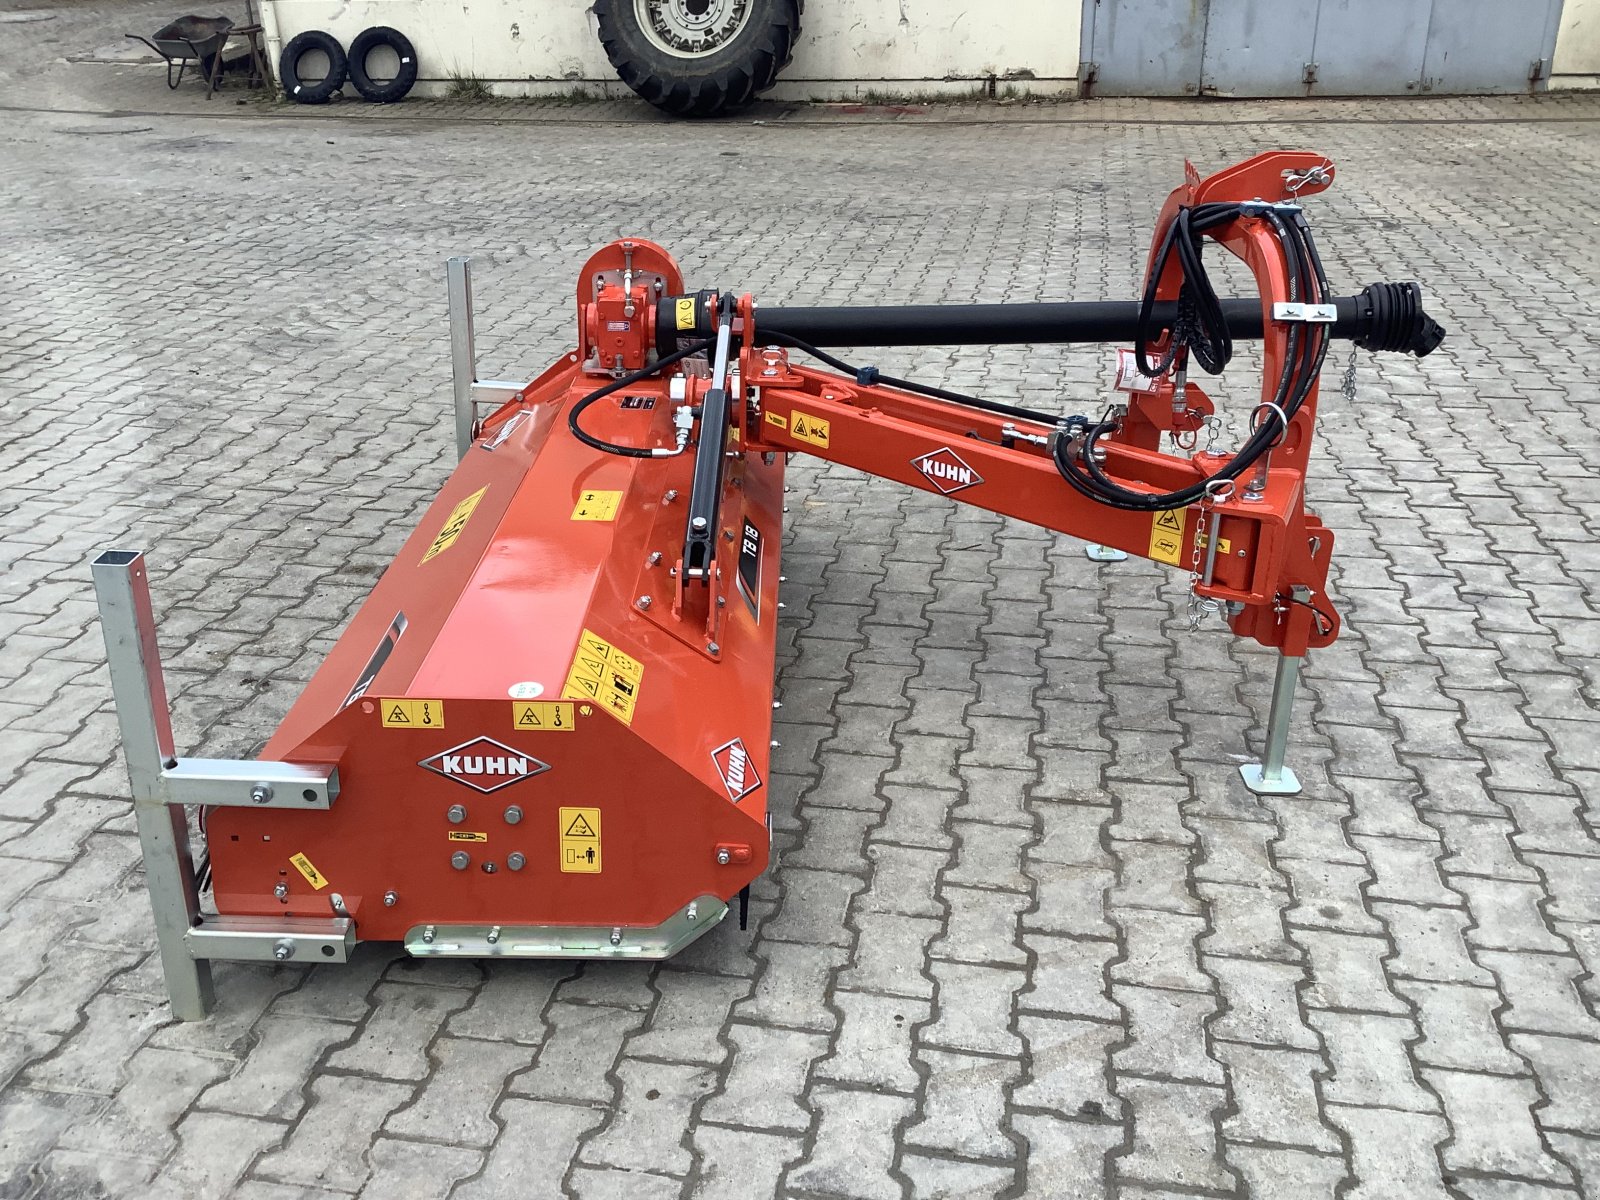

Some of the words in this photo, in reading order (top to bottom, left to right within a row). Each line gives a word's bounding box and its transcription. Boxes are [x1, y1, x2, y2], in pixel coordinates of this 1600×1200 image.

[923, 458, 971, 484] KUHN
[744, 524, 758, 541] 18
[742, 538, 757, 557] TB
[442, 755, 528, 775] KUHN
[727, 744, 746, 794] KUHN
